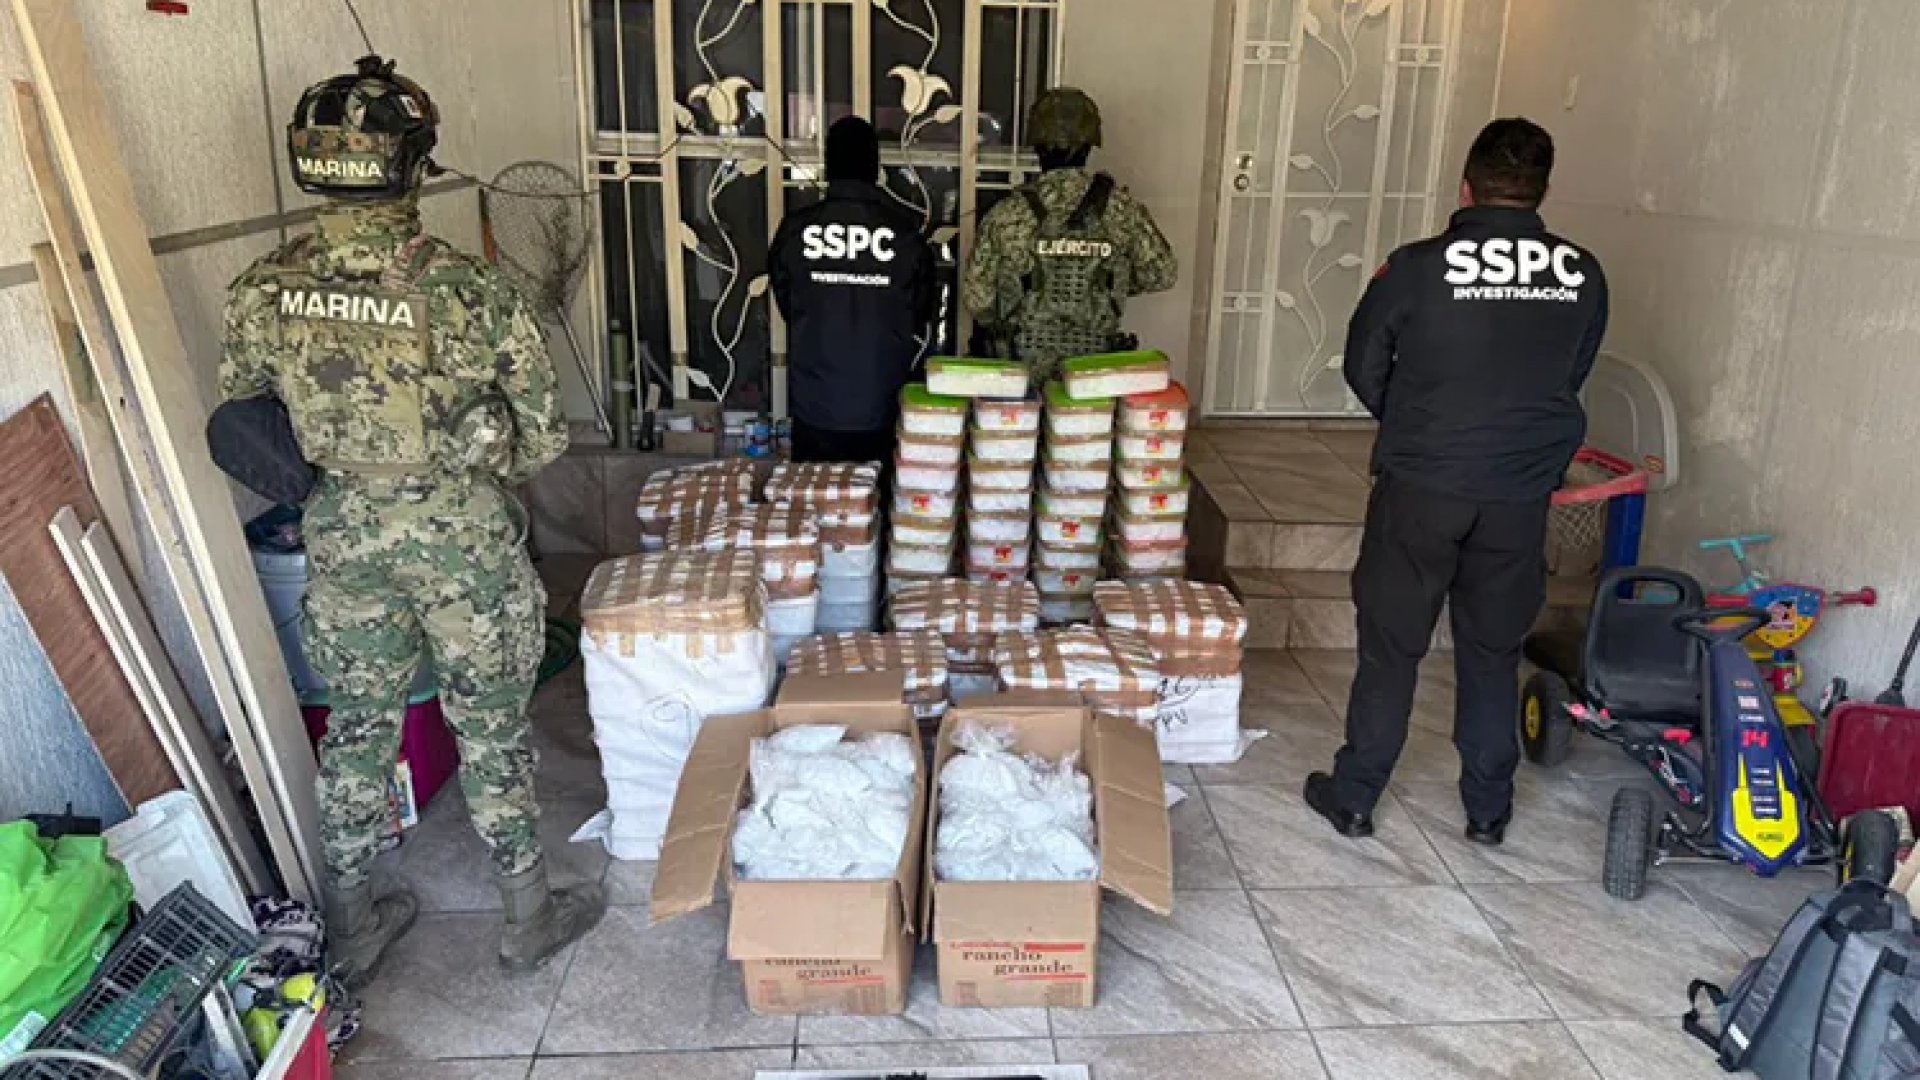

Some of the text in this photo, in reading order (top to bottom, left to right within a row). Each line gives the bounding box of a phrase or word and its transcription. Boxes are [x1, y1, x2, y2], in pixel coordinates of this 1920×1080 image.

[297, 157, 383, 179] MARINA
[802, 223, 896, 261] SSPC
[1443, 237, 1586, 287] SSPC
[1453, 286, 1578, 303] INVESTIGACIÓN
[280, 289, 416, 329] MARINA
[961, 946, 1043, 961] rancho
[795, 963, 871, 980] grande
[993, 959, 1073, 976] grande
